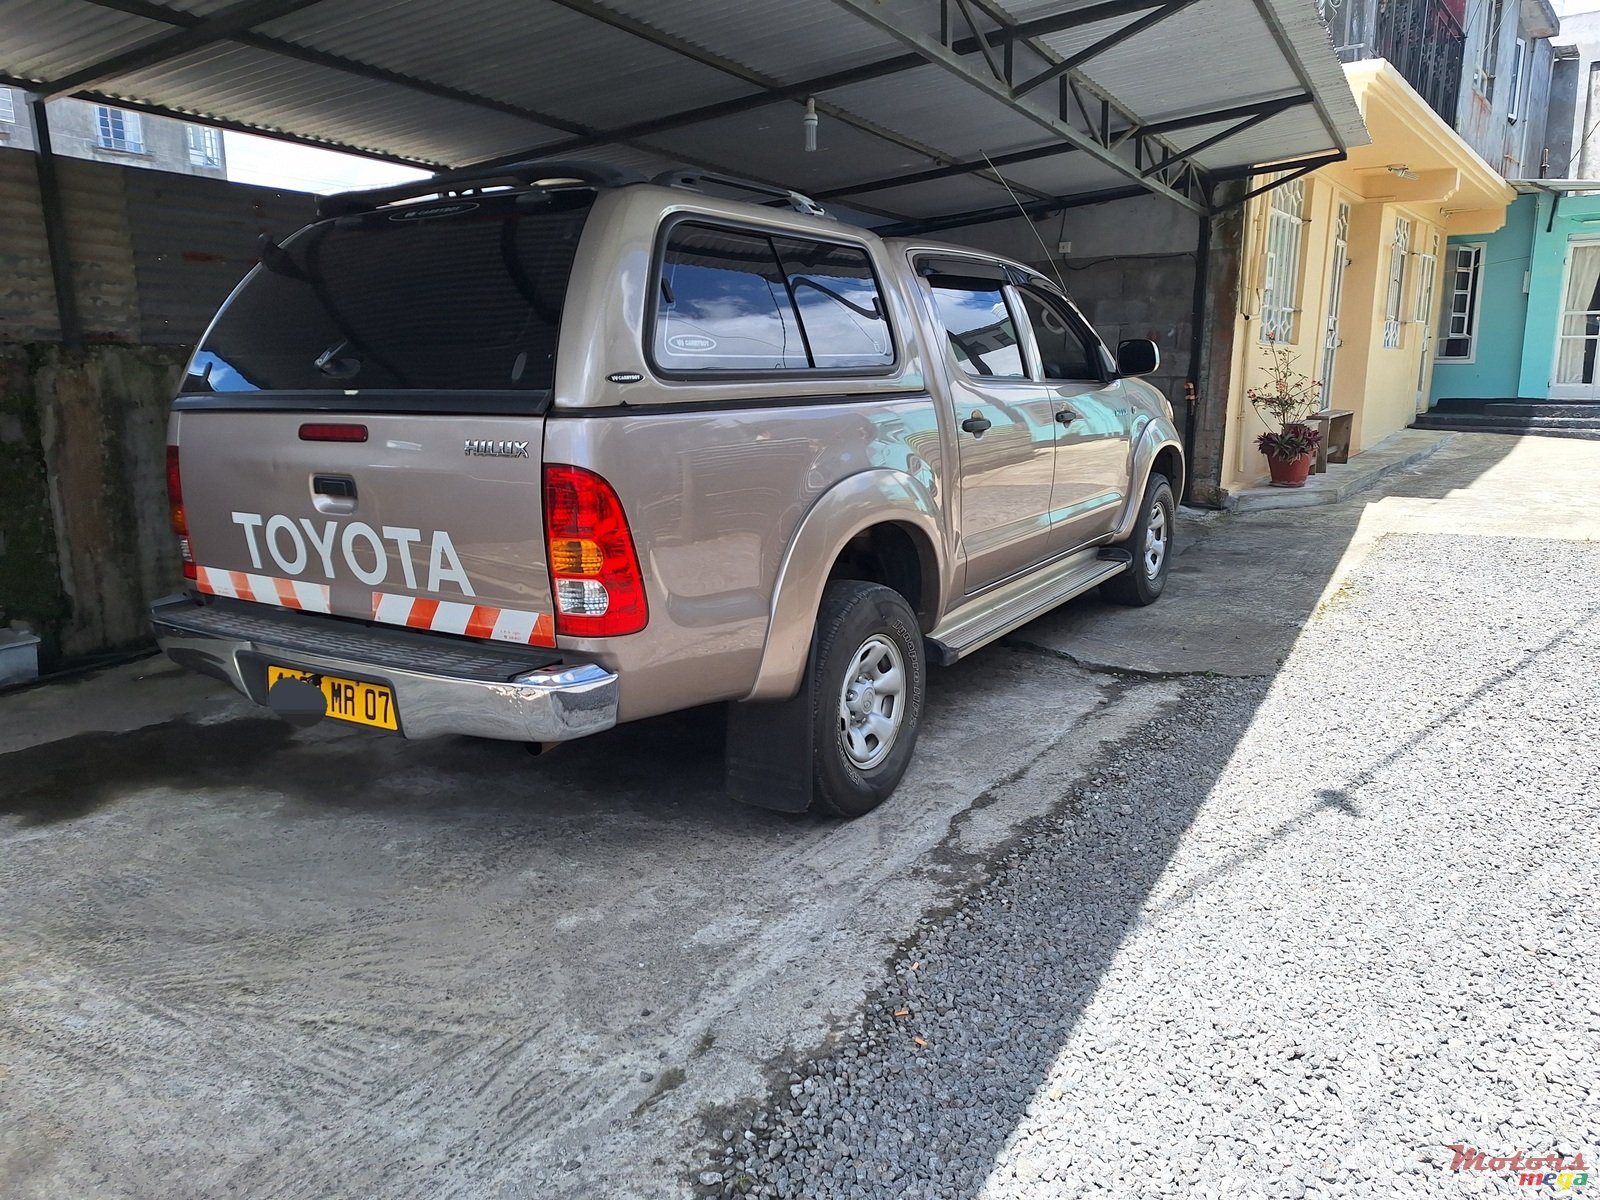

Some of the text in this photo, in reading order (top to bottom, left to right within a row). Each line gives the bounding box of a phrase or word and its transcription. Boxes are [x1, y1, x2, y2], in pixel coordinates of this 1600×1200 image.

[464, 439, 529, 458] HILUX
[231, 511, 476, 597] TOYOTA
[331, 682, 390, 723] MR 07
